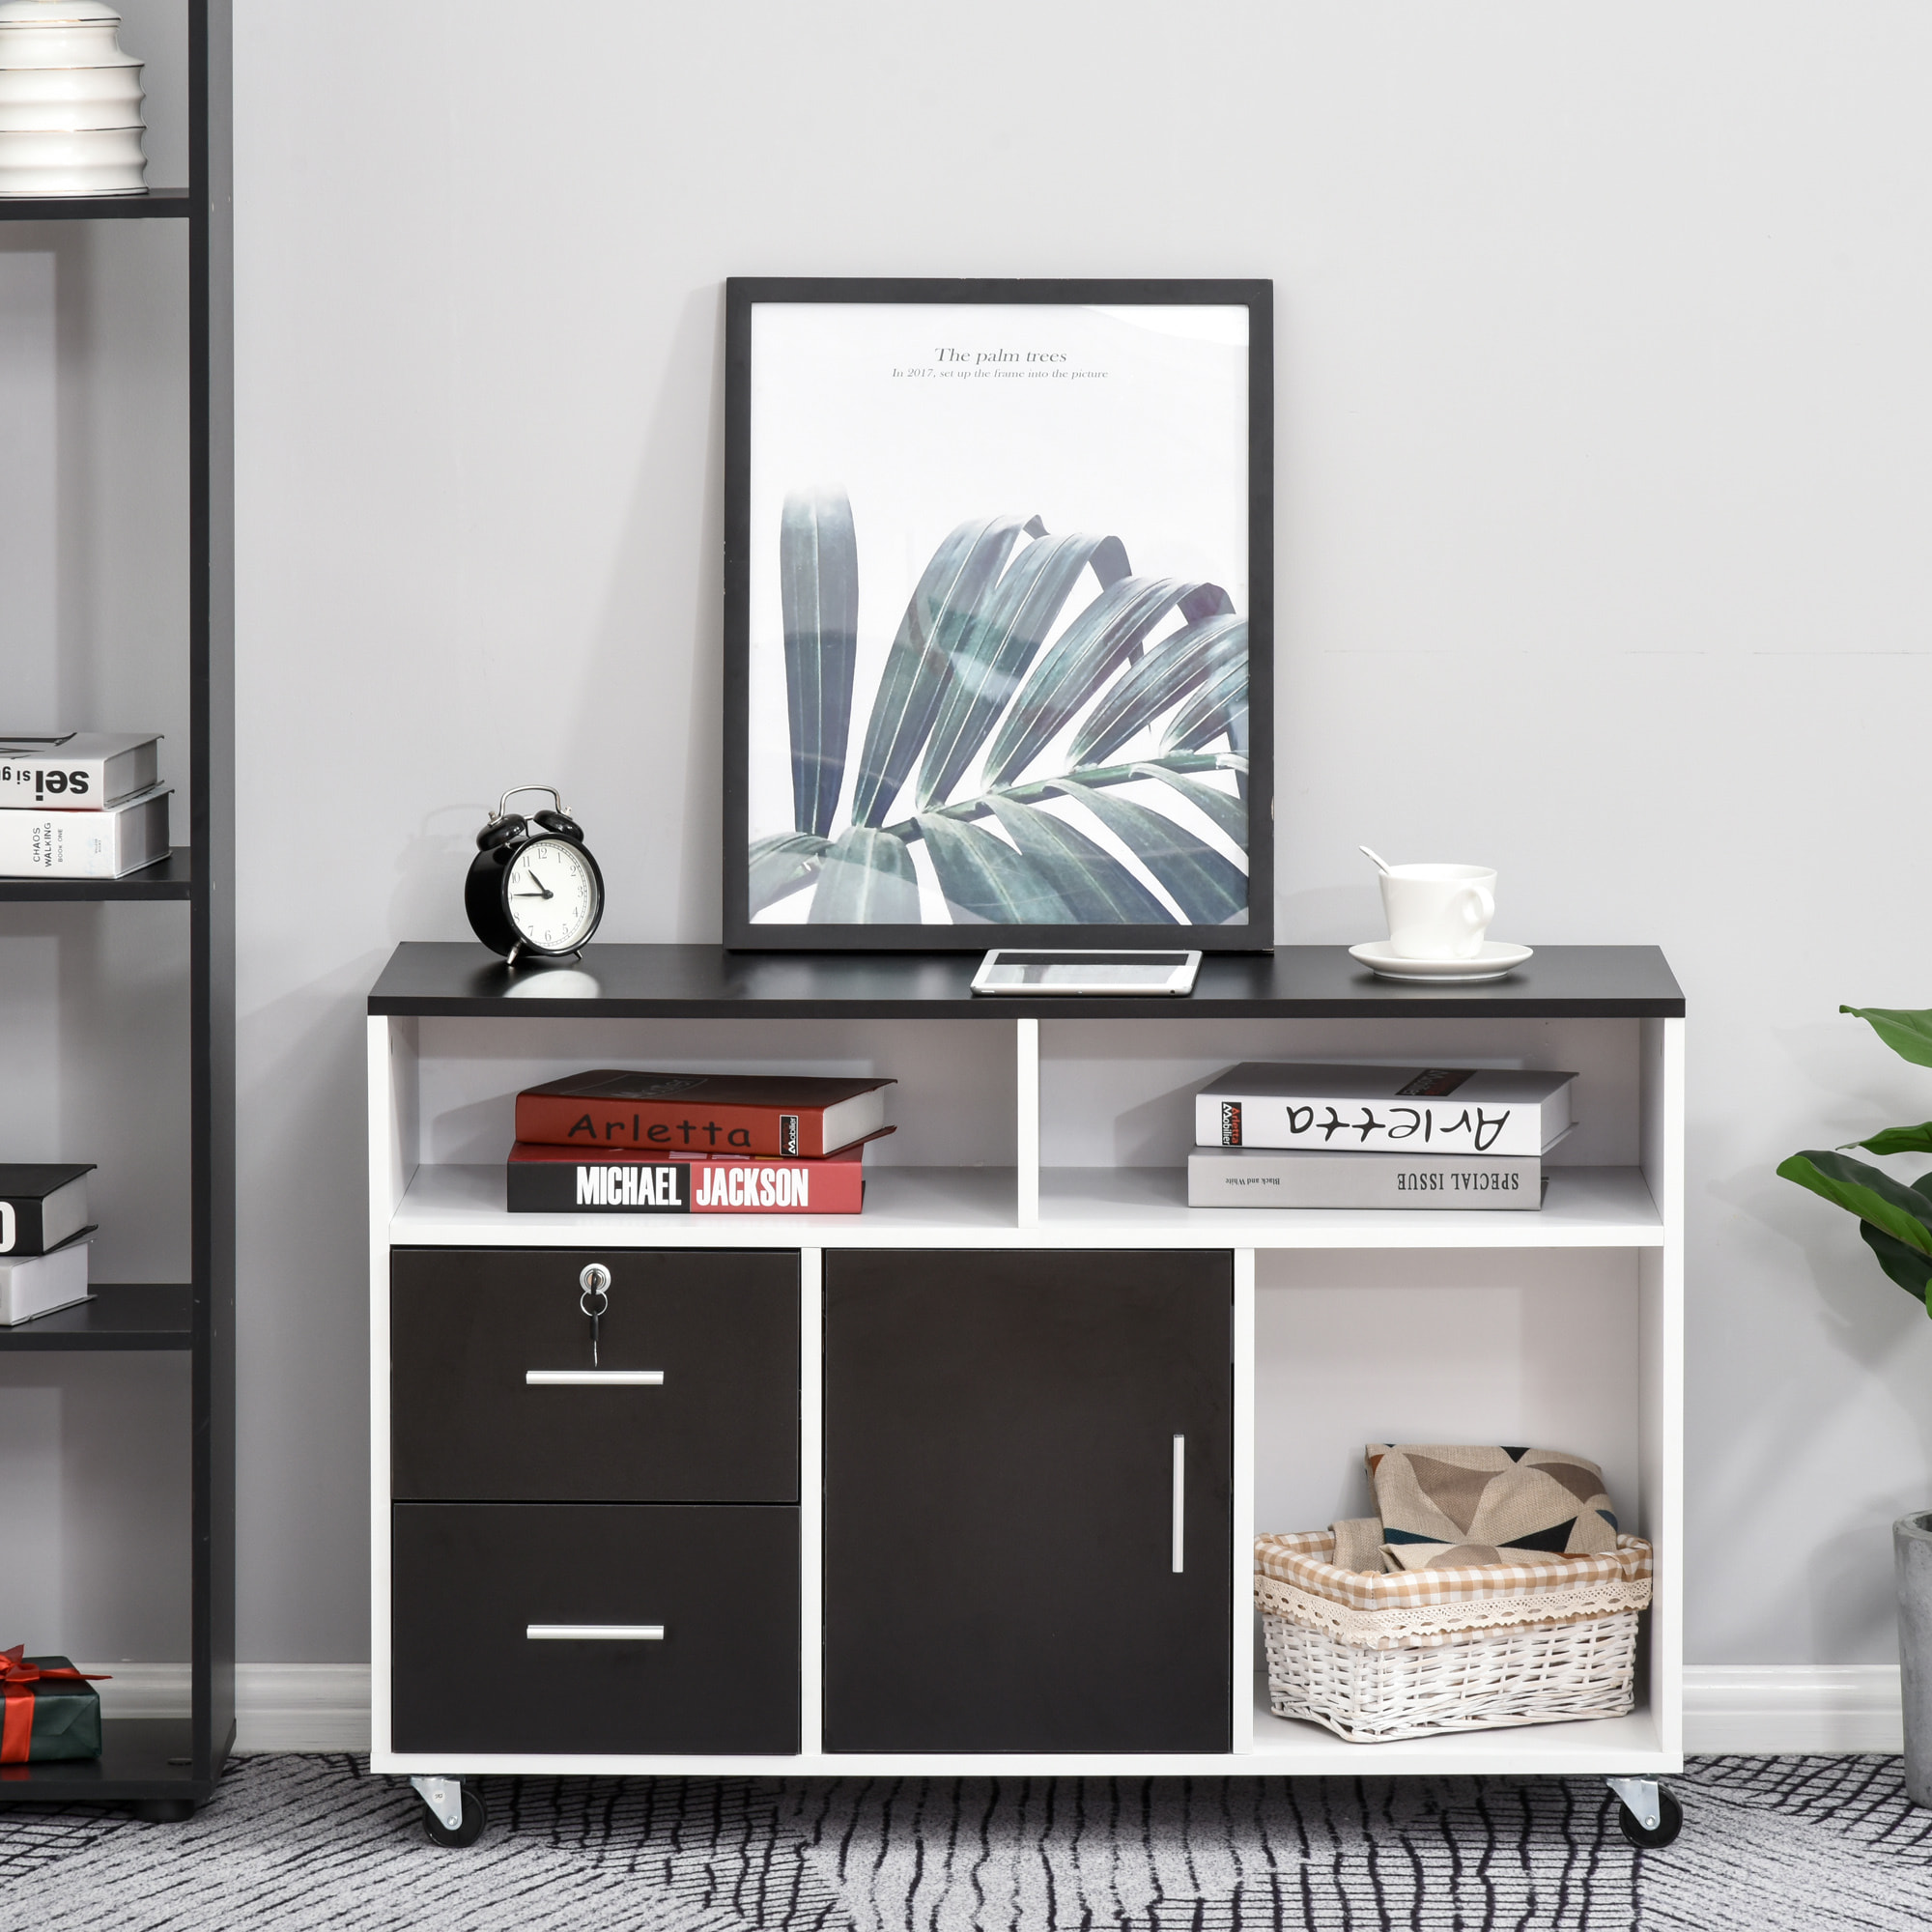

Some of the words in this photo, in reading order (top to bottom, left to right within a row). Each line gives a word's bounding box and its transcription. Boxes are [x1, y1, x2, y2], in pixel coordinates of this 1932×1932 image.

[934, 348, 970, 362] The
[976, 348, 1020, 365] palm
[1026, 350, 1067, 362] trees
[892, 368, 903, 378] In
[907, 368, 936, 379] 2017,
[939, 369, 953, 378] set
[957, 370, 971, 380] up
[974, 368, 991, 378] the
[993, 368, 1025, 378] frame
[1028, 368, 1048, 378] into
[1051, 368, 1068, 378] the
[1071, 368, 1109, 380] picture
[35, 770, 90, 802] sei
[43, 822, 52, 867] WALKING
[537, 847, 548, 859] 12
[570, 865, 577, 876] 2
[511, 872, 520, 884] 10
[527, 925, 534, 937] 7
[562, 923, 568, 934] 5
[544, 930, 552, 942] 6
[1222, 1102, 1233, 1145] Mobilier
[1232, 1107, 1240, 1144] Arletta
[1286, 1105, 1511, 1151] Arletta
[567, 1113, 752, 1149] Arletta
[576, 1166, 682, 1207] MICHAEL
[696, 1167, 810, 1208] JACKSON
[1225, 1178, 1246, 1186] White
[1246, 1178, 1260, 1186] and
[1261, 1178, 1280, 1186] Black
[1397, 1173, 1444, 1190] ISSUE
[1450, 1173, 1520, 1190] SPECIAL
